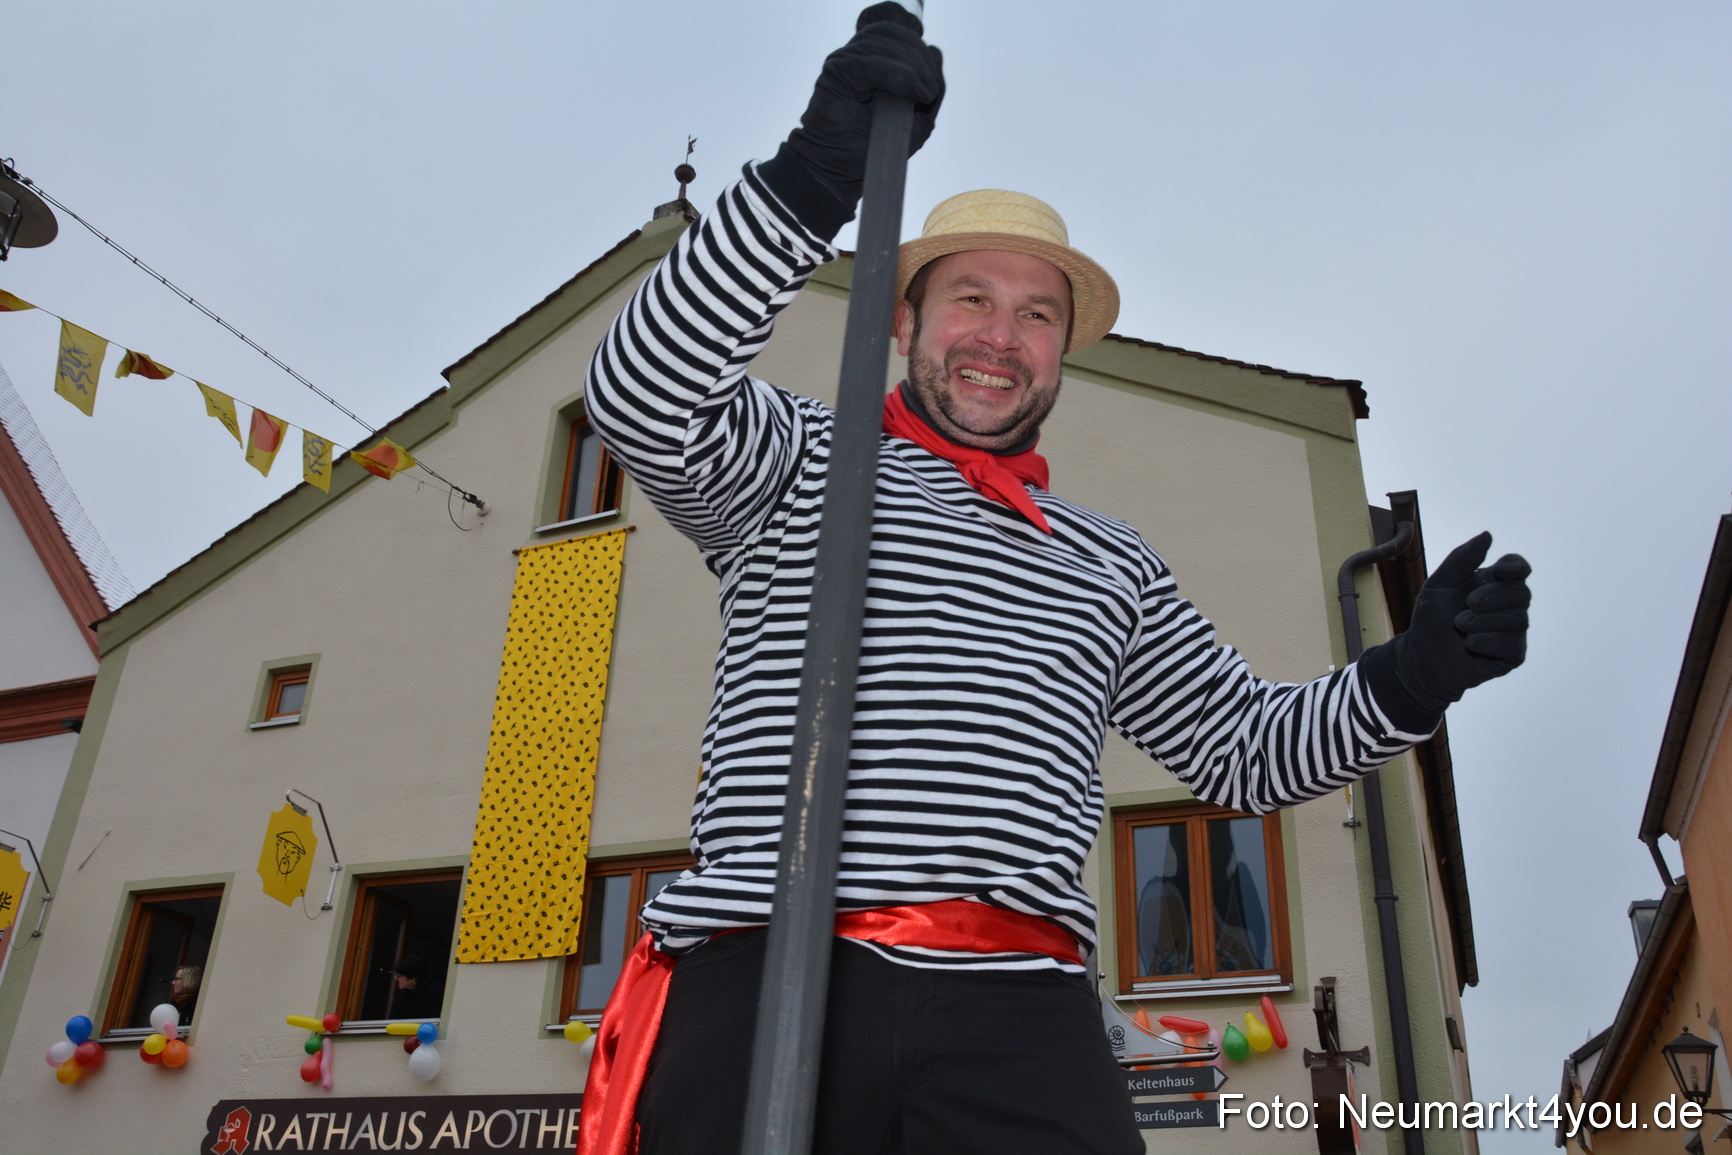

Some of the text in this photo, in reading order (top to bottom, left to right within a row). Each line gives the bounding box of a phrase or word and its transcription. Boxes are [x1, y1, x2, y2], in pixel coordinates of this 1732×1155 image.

[1127, 1075, 1195, 1091] Keltenhaus
[1134, 1108, 1204, 1124] Barfußpark
[253, 1110, 427, 1151] RATHAUS
